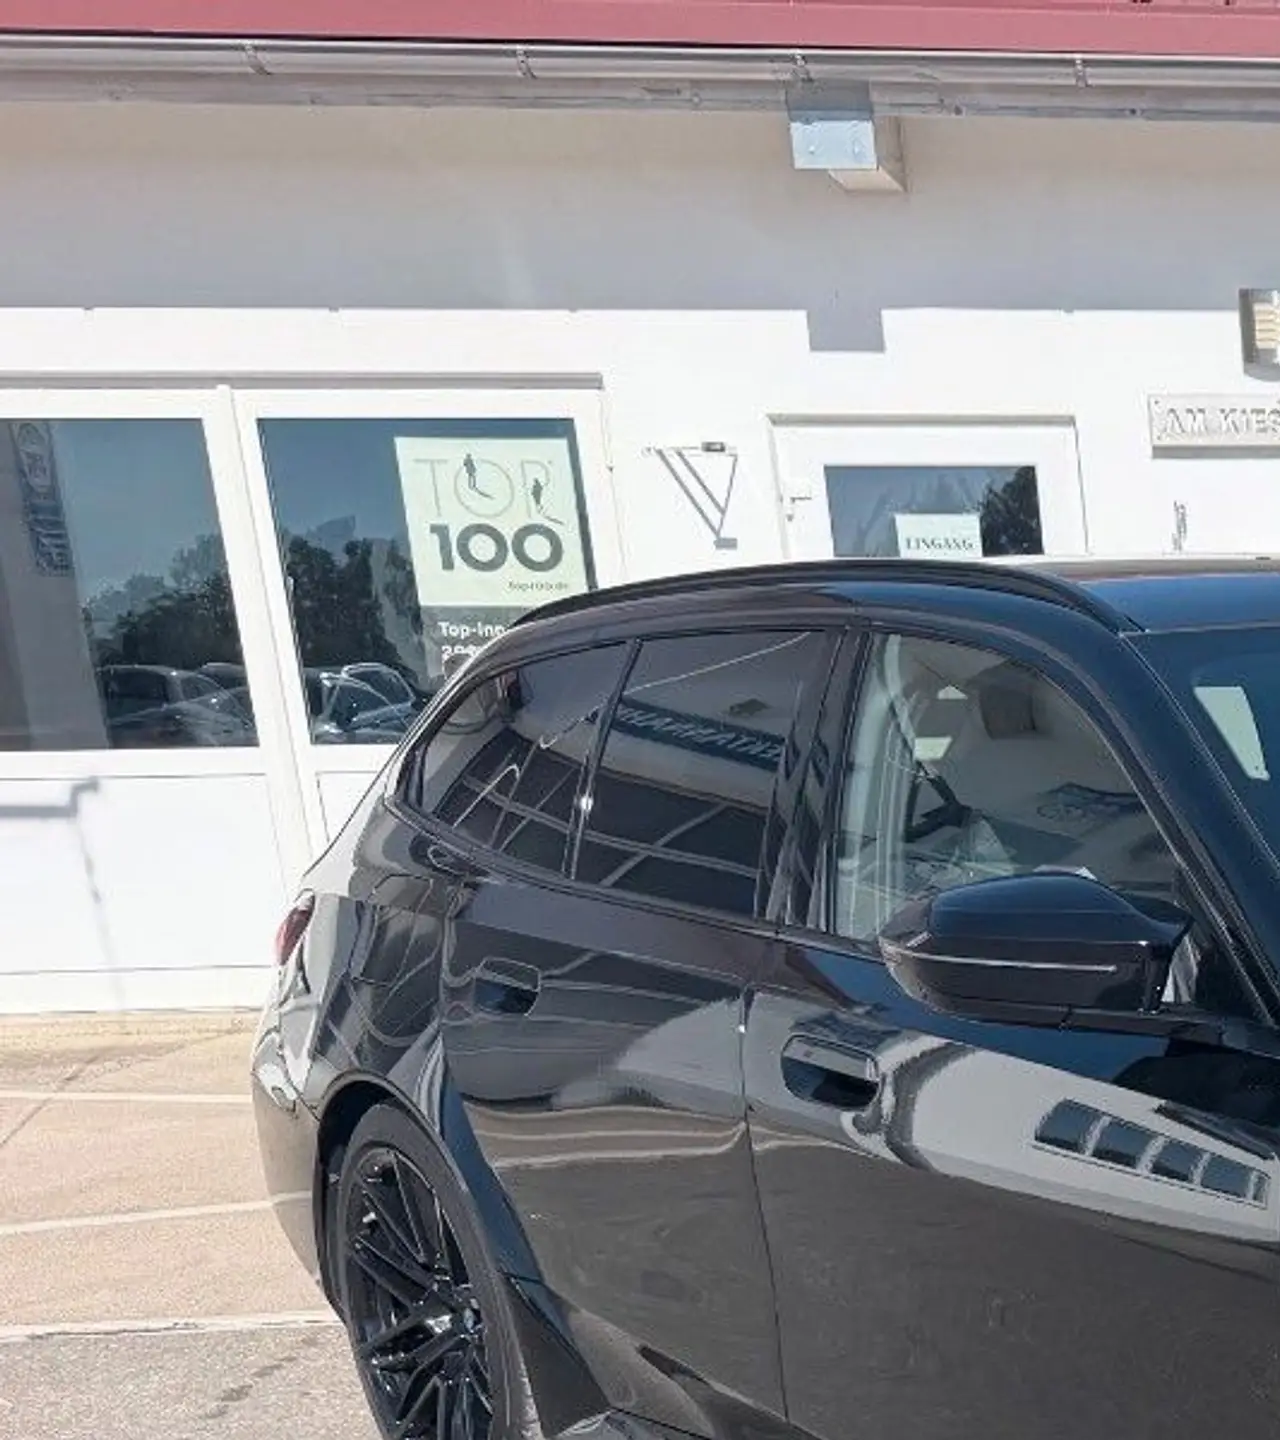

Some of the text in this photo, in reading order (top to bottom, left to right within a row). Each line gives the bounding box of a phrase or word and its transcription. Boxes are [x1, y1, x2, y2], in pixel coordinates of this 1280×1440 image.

[1163, 407, 1208, 433] AM
[413, 457, 564, 524] TOP
[429, 522, 563, 572] 100
